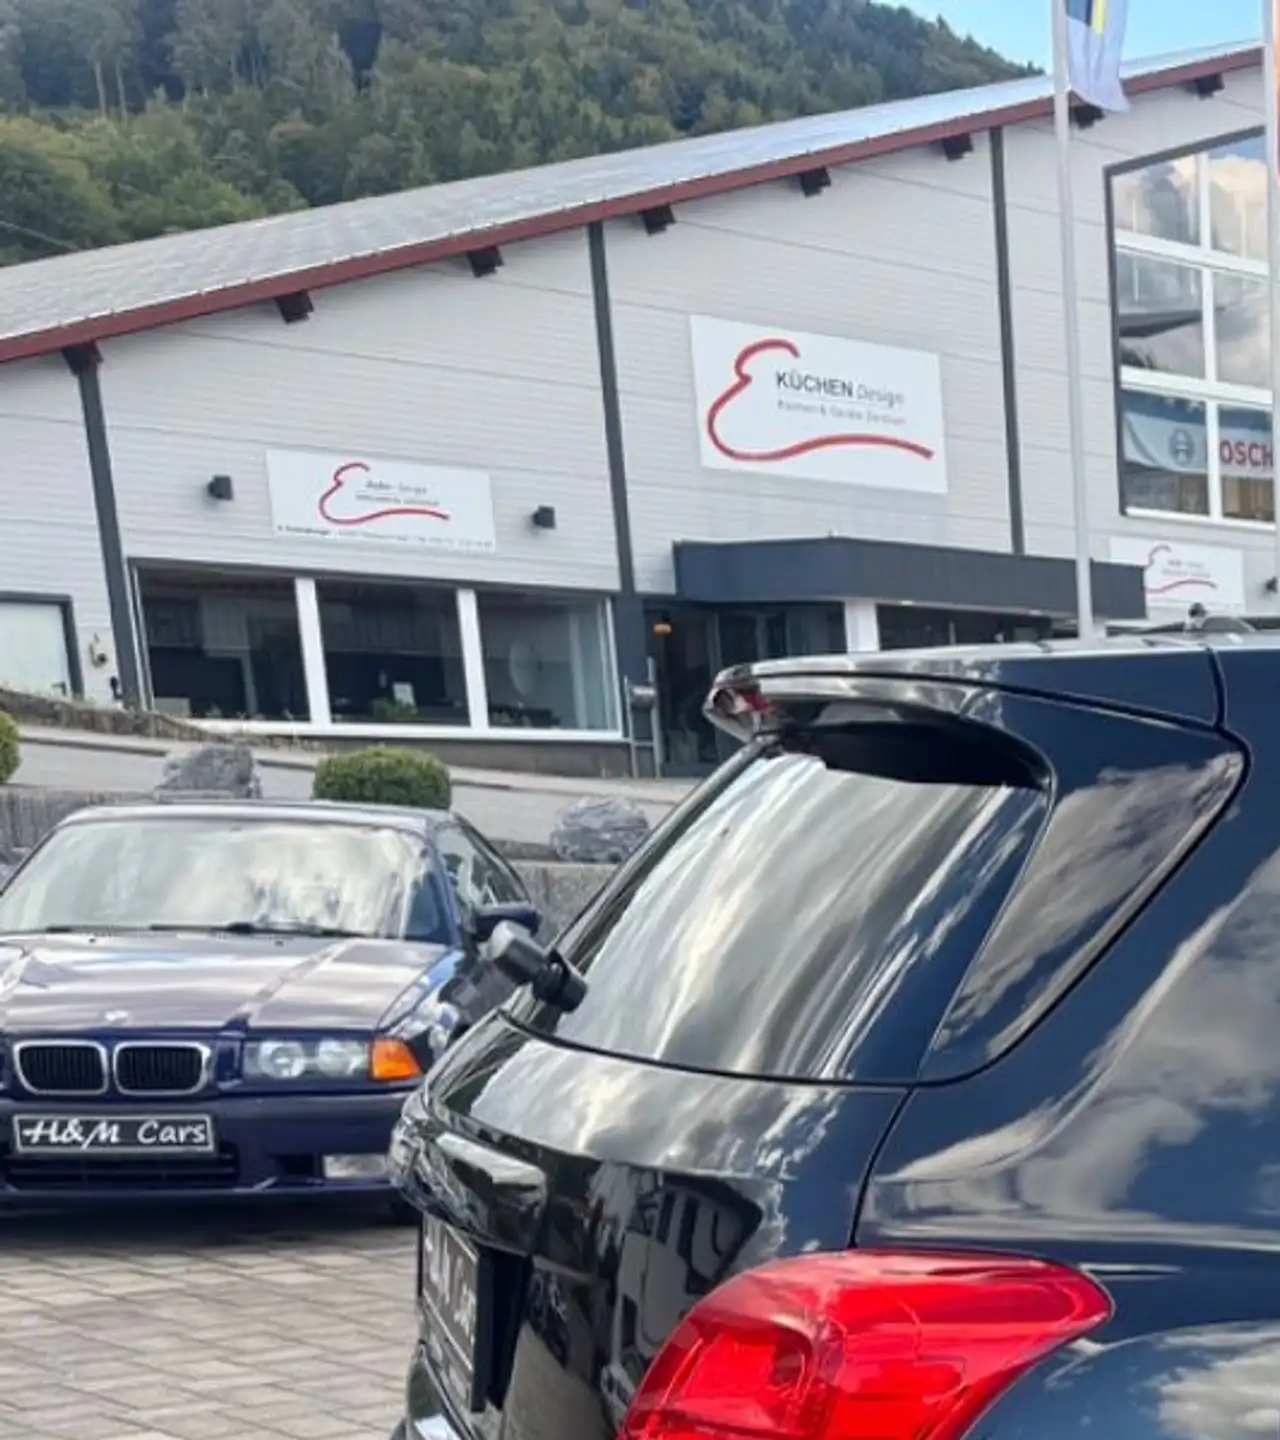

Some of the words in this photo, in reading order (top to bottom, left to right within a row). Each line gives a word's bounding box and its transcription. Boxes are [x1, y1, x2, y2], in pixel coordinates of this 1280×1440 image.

[1204, 438, 1274, 467] OSCH
[22, 1117, 120, 1150] H&M
[137, 1119, 206, 1145] Cars
